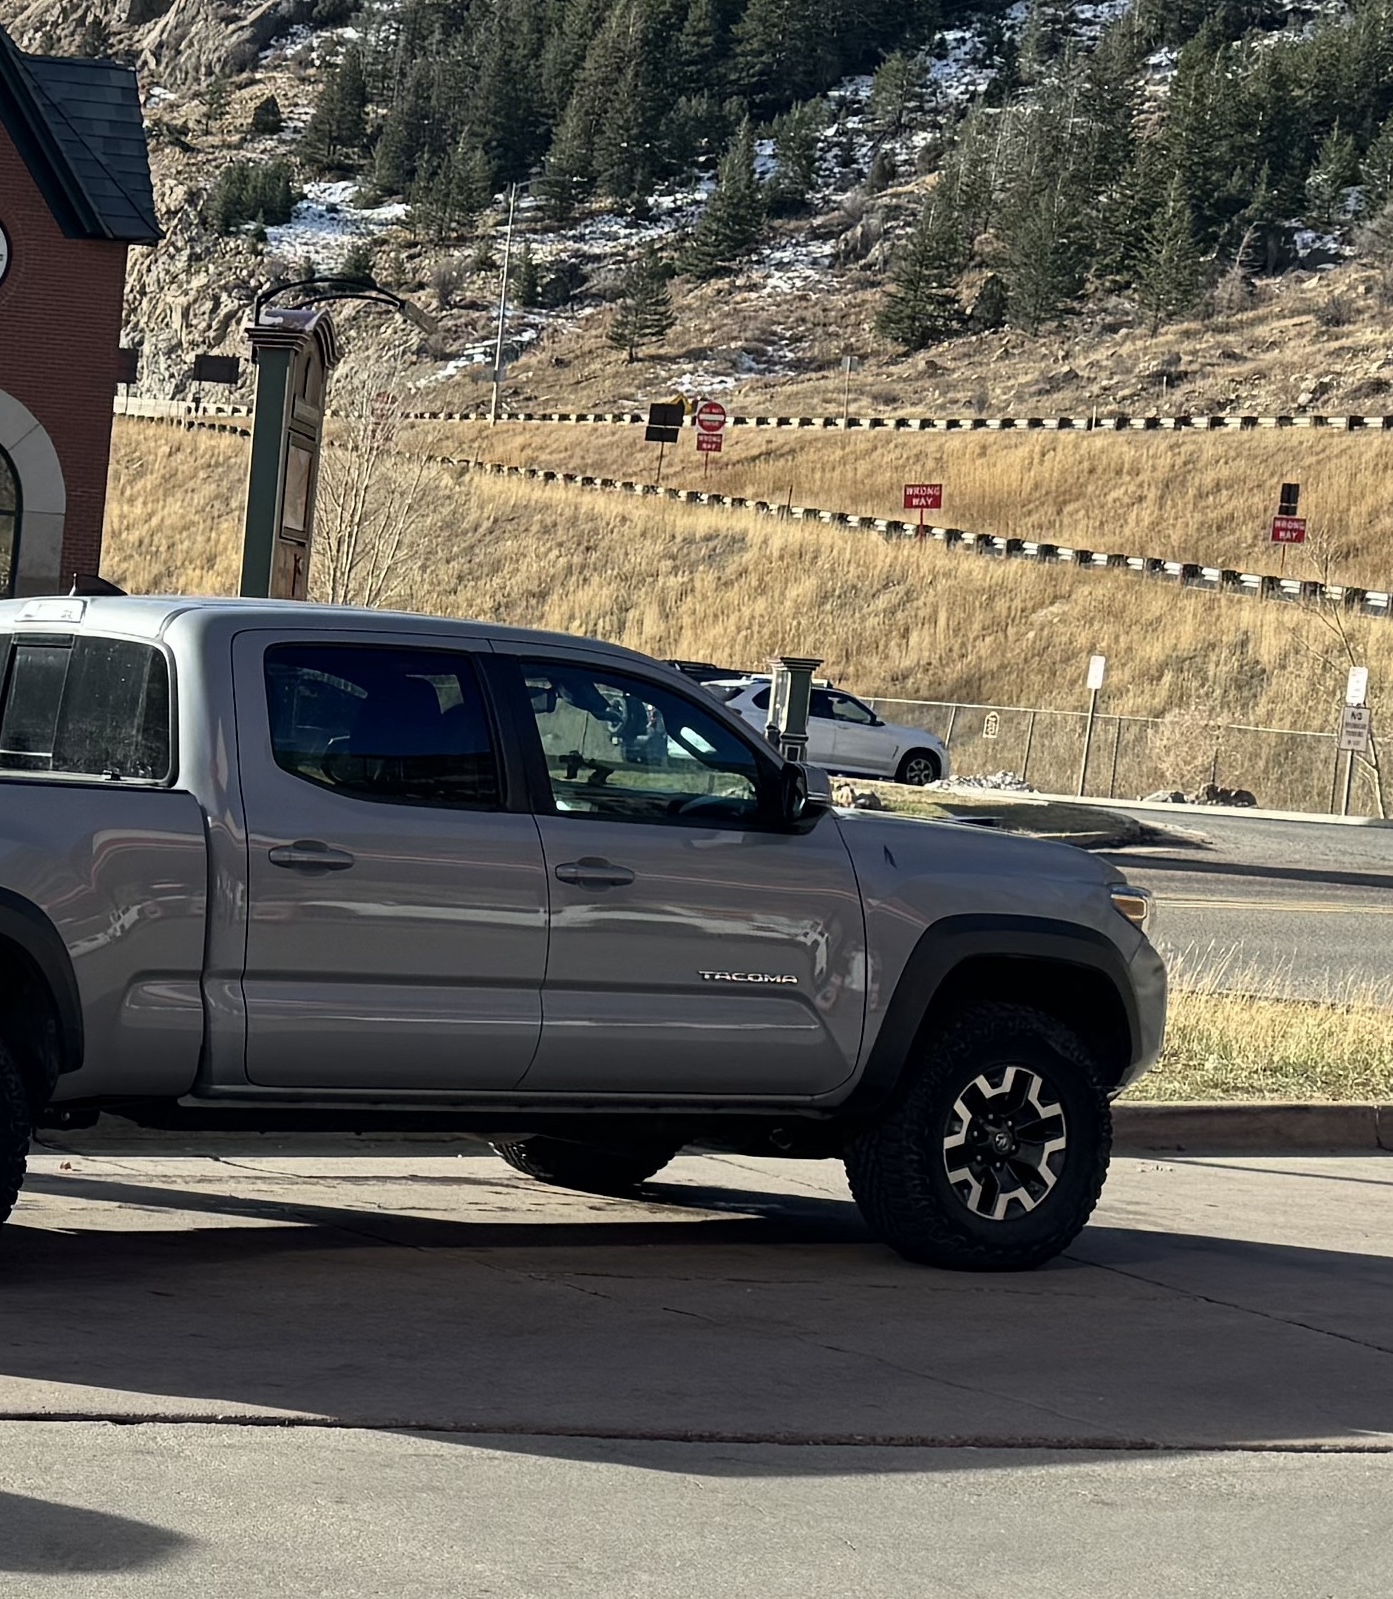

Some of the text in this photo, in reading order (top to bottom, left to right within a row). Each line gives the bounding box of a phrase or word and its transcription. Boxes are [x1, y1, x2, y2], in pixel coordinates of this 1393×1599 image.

[906, 486, 940, 496] WRONG
[912, 496, 933, 506] WAY
[1279, 530, 1298, 540] WAY
[698, 970, 799, 984] TACOMA
